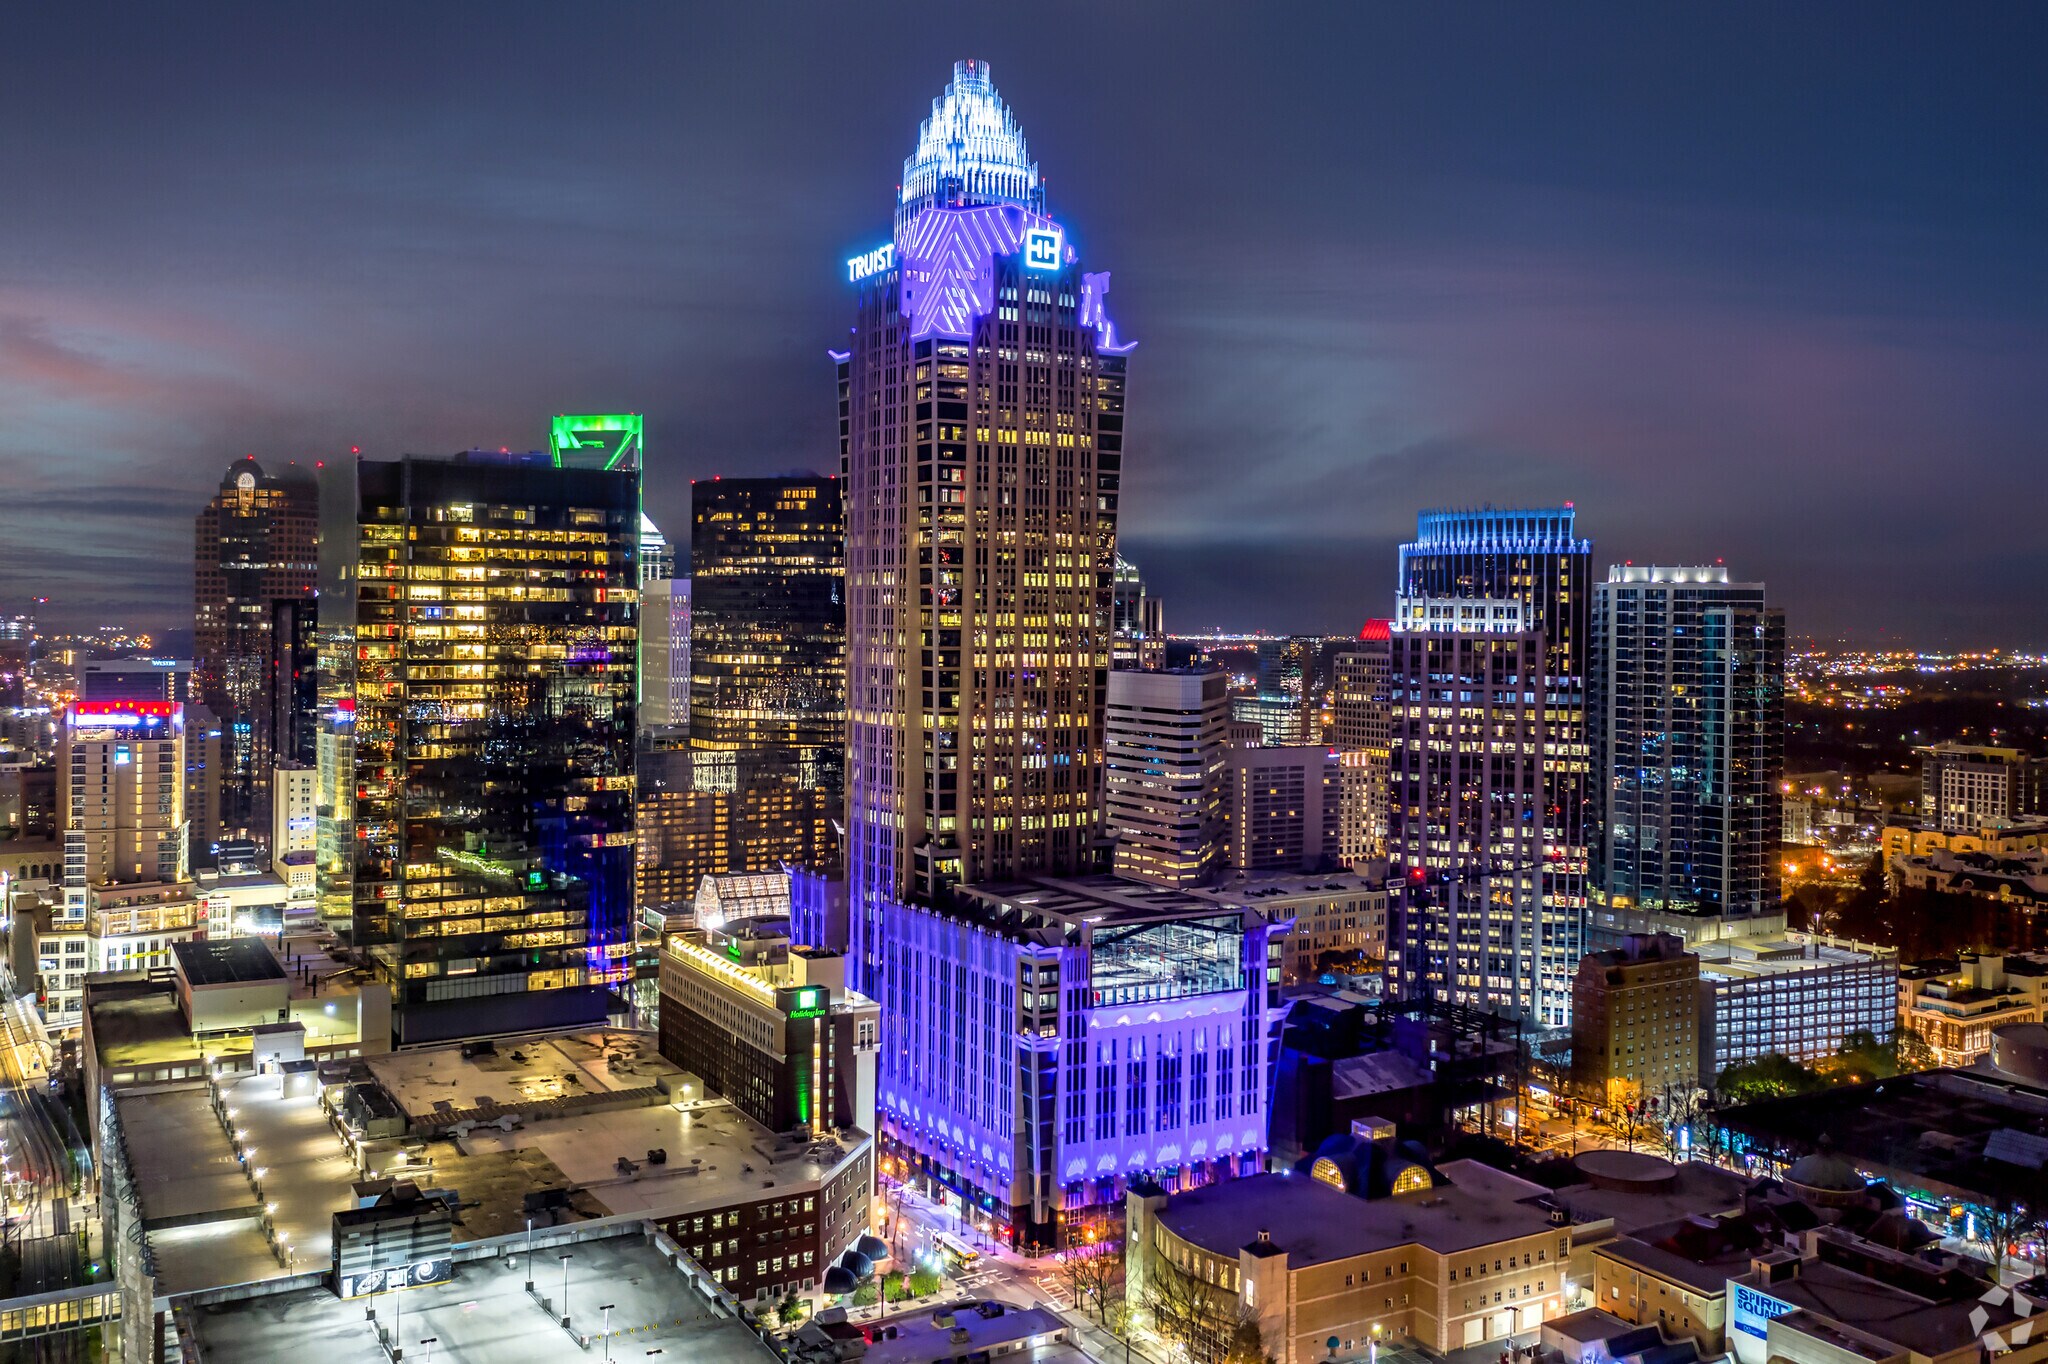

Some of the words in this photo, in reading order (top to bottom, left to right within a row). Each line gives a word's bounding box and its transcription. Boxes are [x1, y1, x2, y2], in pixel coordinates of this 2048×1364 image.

[847, 244, 894, 282] TRUIST
[790, 1010, 815, 1019] Holiday
[1738, 1288, 1789, 1314] SPIRIT
